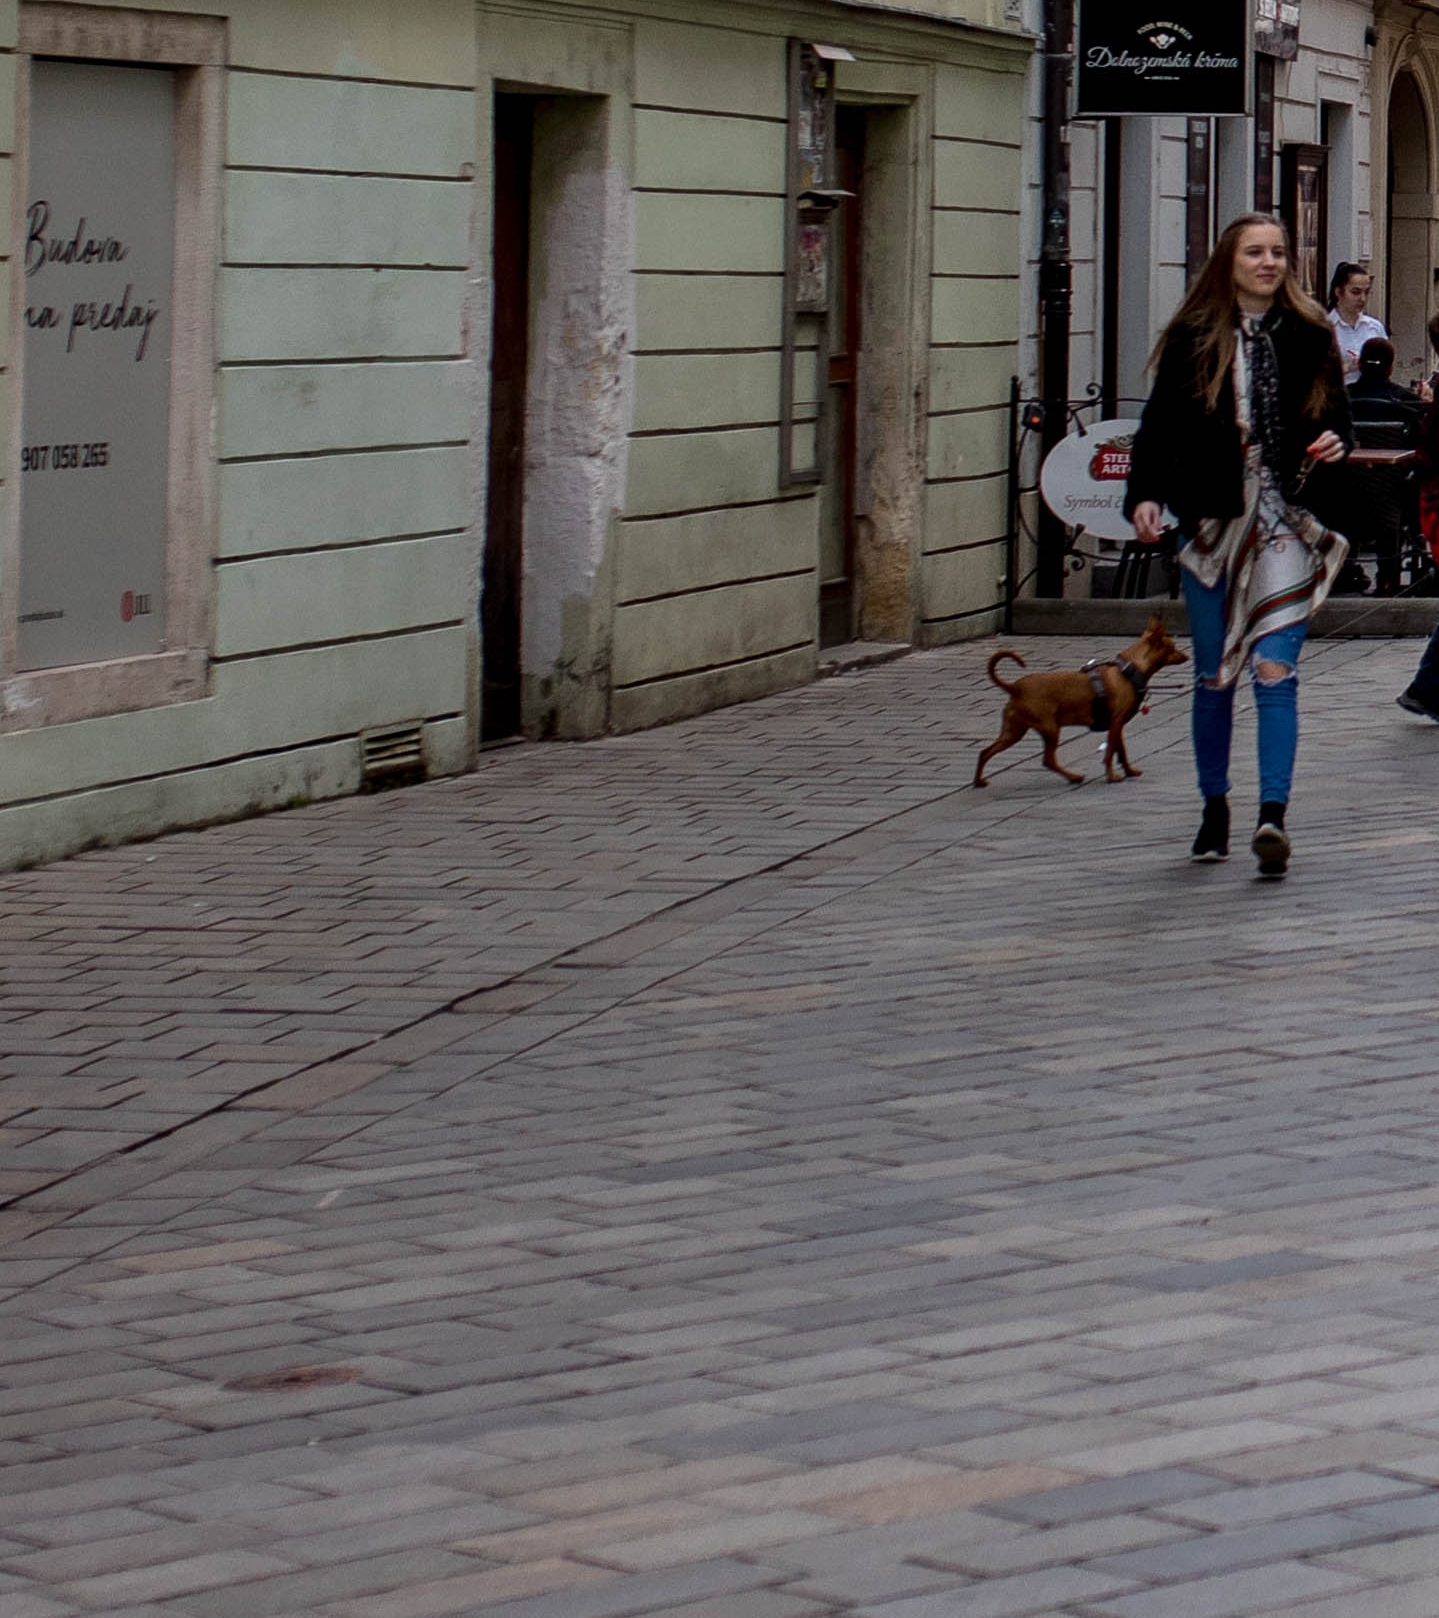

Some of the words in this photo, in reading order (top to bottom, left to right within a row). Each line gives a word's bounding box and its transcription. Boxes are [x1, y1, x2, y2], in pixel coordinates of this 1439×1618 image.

[1085, 46, 1192, 75] Dolnozemská
[25, 200, 129, 277] Budova
[66, 283, 159, 362] predaj
[22, 446, 50, 472] 907
[81, 441, 110, 469] 265
[1101, 464, 1131, 475] ART
[1102, 453, 1132, 464] STEL
[1063, 494, 1113, 512] Symbol
